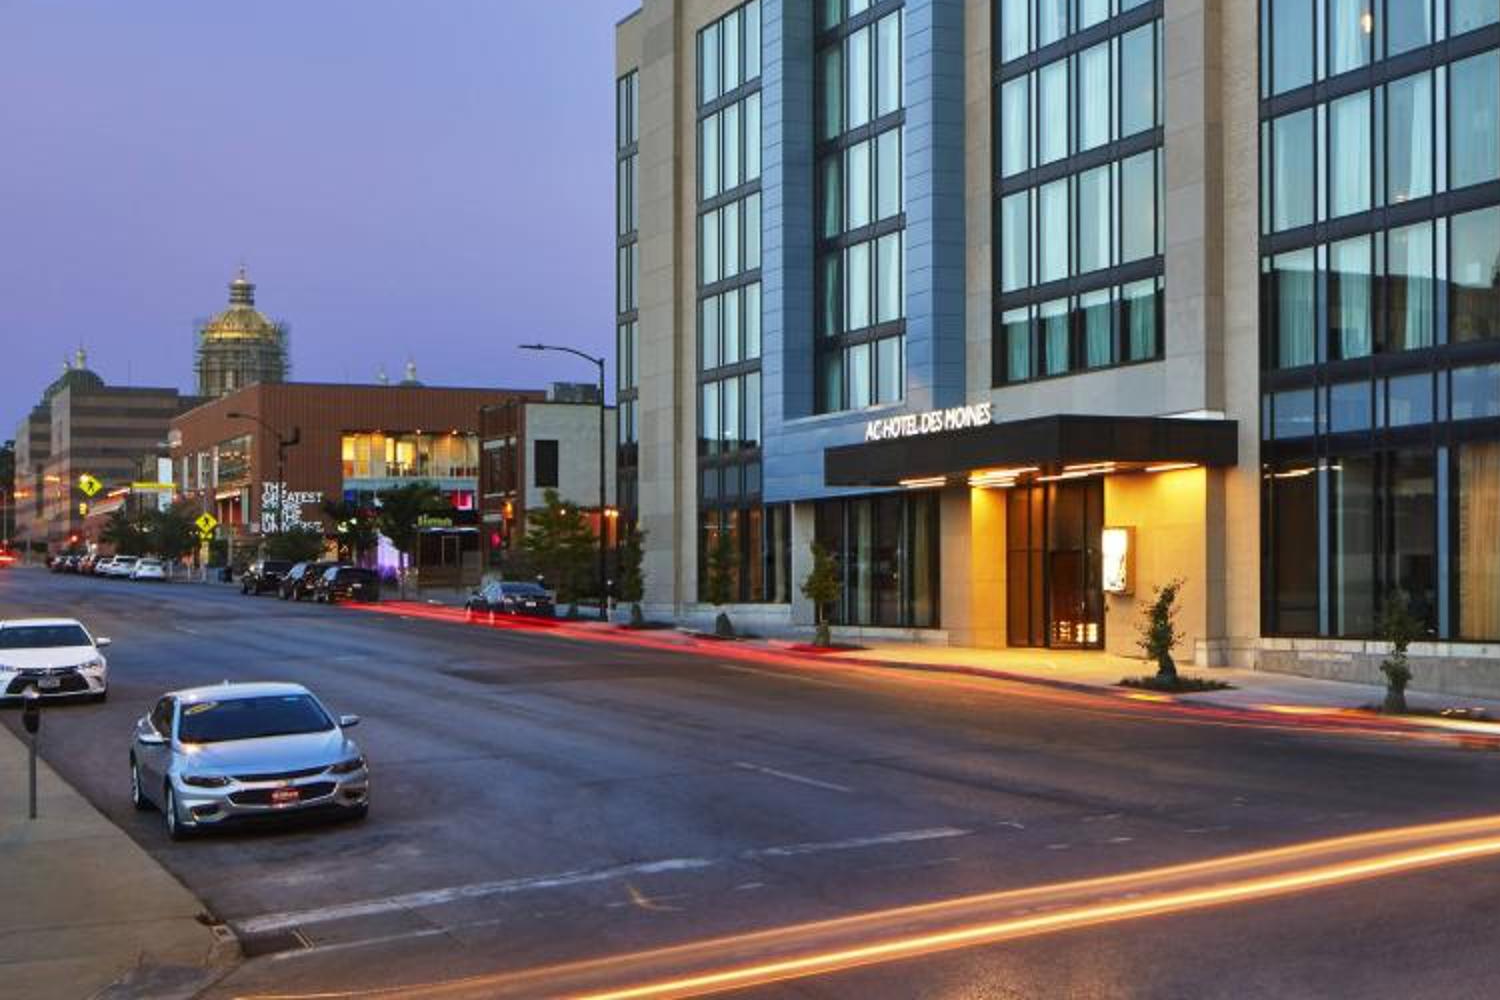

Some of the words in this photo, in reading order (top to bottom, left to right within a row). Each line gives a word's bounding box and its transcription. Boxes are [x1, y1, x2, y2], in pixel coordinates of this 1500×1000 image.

[865, 420, 882, 441] AC
[883, 414, 918, 438] HOTEL
[921, 410, 943, 434] DES
[944, 401, 992, 430] MOINES
